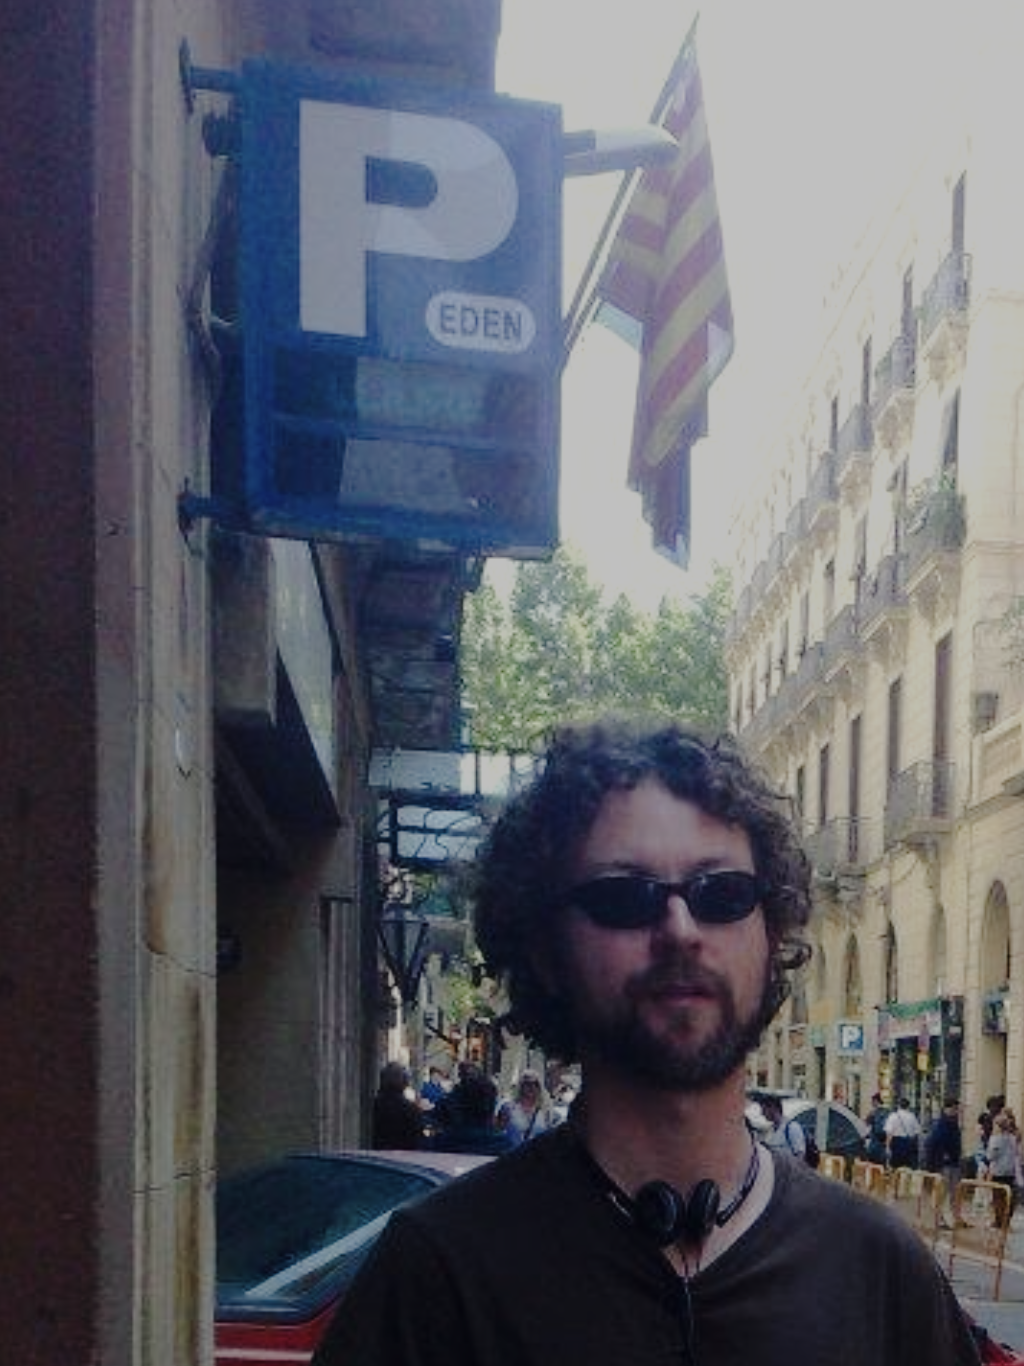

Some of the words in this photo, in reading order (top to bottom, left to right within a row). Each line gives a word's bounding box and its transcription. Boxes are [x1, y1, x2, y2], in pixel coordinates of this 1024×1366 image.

[300, 99, 519, 337] P
[439, 303, 523, 341] EDEN
[842, 1026, 861, 1048] P
